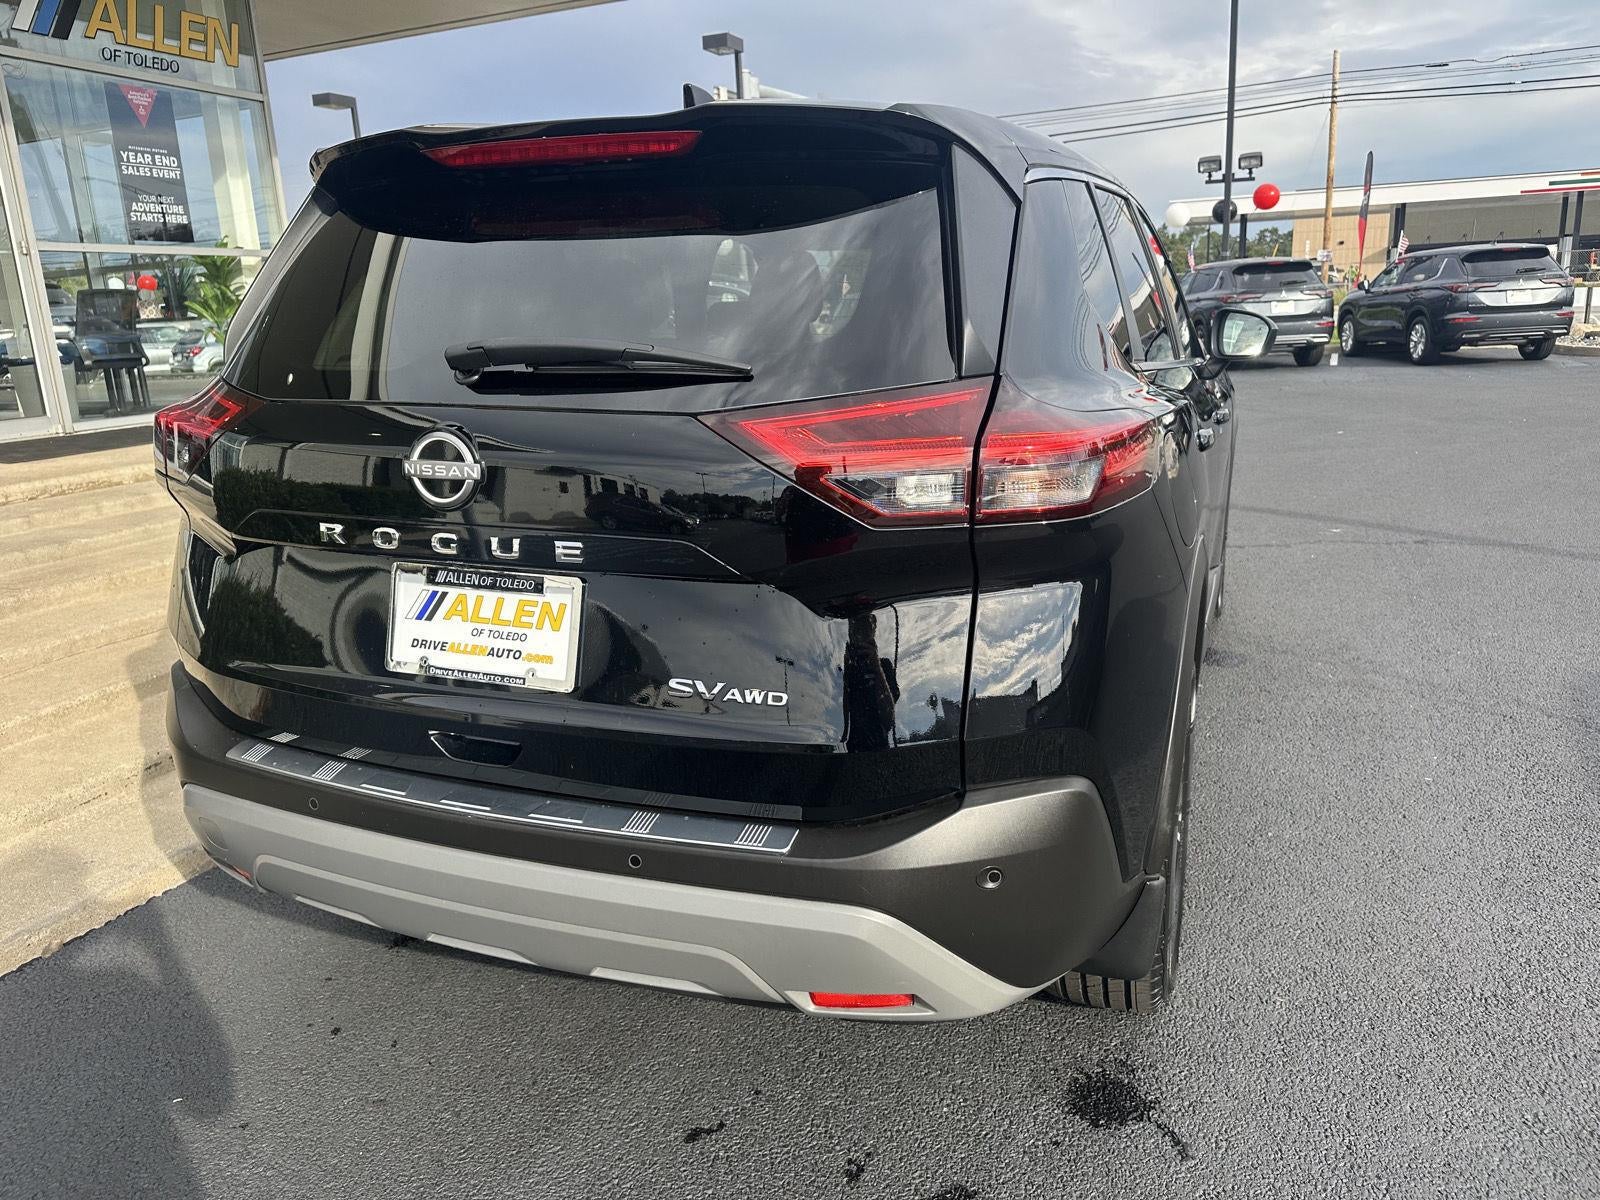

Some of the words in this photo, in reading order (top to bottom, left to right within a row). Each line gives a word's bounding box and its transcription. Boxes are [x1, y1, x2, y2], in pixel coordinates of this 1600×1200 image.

[84, 0, 239, 68] ALLEN
[101, 46, 121, 62] OF
[125, 51, 180, 73] TOLEDO
[120, 150, 153, 165] YEAR
[154, 154, 178, 167] END
[121, 165, 151, 177] SALES
[152, 168, 181, 179] EVENT
[131, 201, 185, 214] ADVENTURE
[137, 194, 157, 203] YOUR
[157, 196, 175, 204] NEXT
[130, 212, 164, 223] STARTS
[165, 213, 189, 224] HERE
[404, 461, 479, 478] NISSAN
[319, 522, 585, 564] ROGUE
[446, 570, 480, 586] ALLEN
[480, 575, 494, 586] OF
[496, 578, 535, 590] TOLEDO
[443, 593, 567, 632] ALLEN
[471, 628, 485, 638] OF
[487, 630, 528, 642] TOLEDO
[411, 638, 554, 665] DRIVEALLENAUTO.com
[667, 678, 727, 701] SV
[722, 687, 789, 706] AWD
